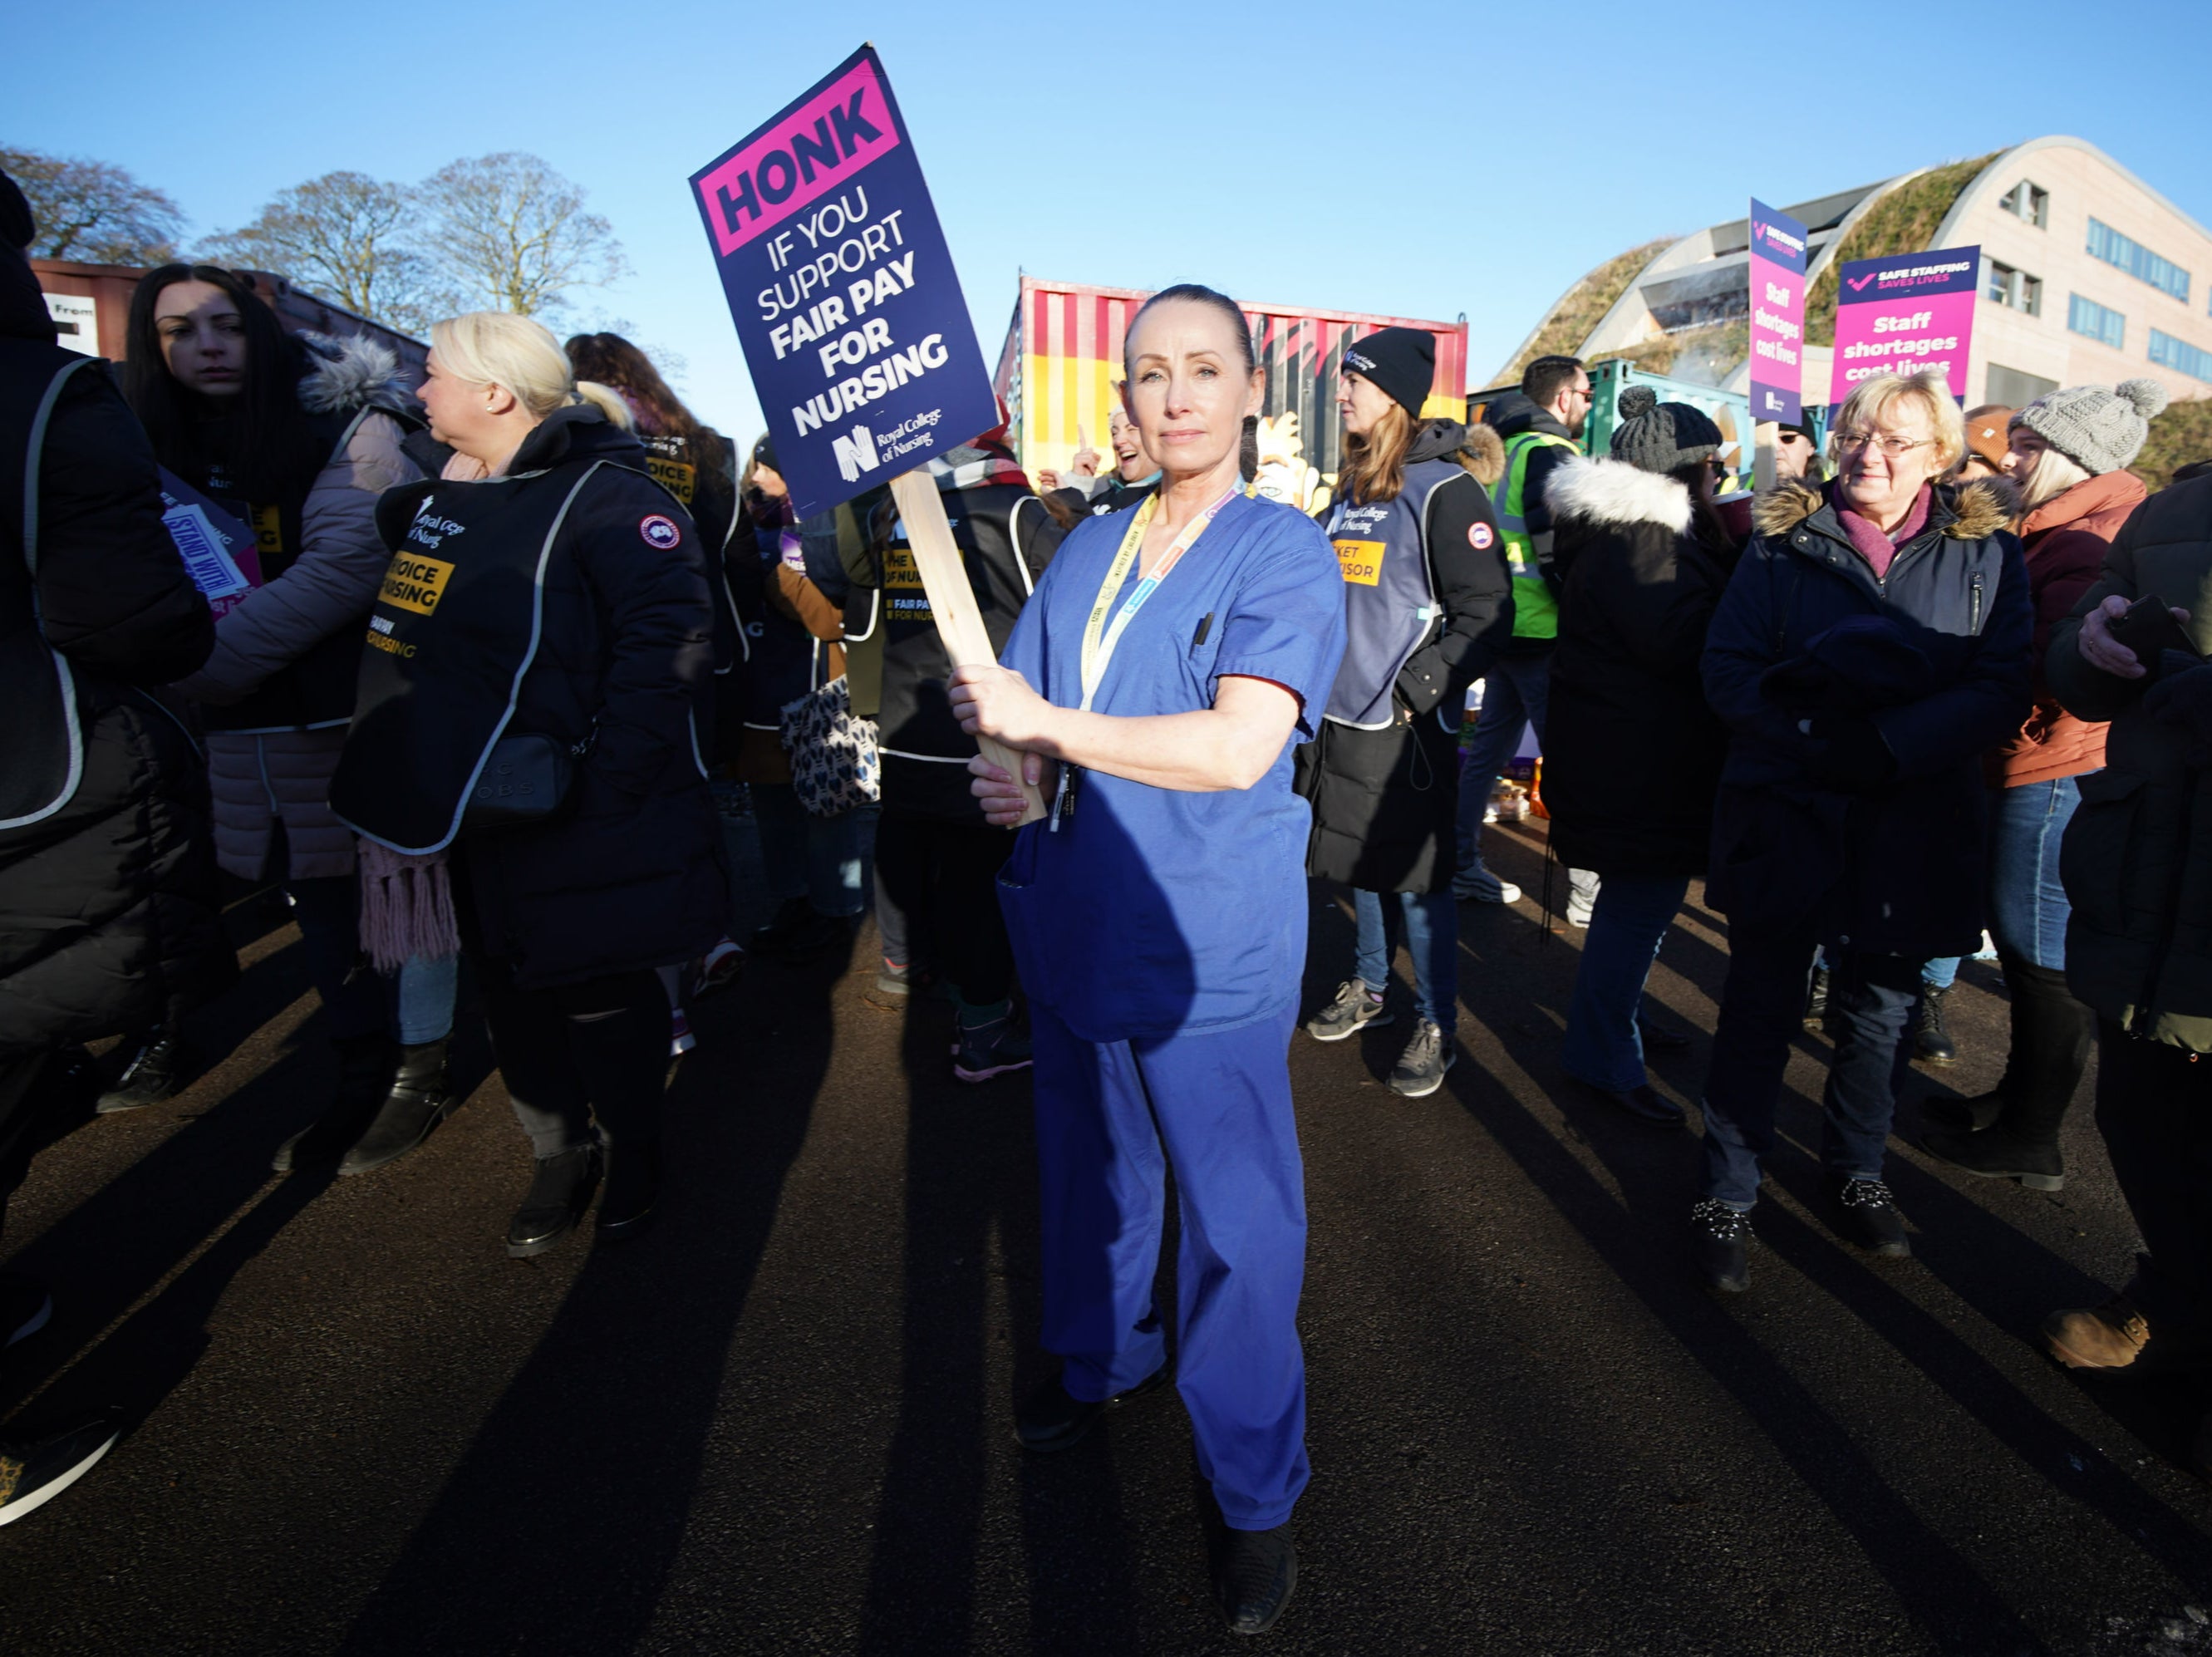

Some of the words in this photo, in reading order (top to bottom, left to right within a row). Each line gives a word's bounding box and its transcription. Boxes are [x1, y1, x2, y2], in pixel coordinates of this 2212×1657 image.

[716, 86, 884, 235] HONK
[766, 230, 794, 272] IF
[797, 185, 869, 249] YOU
[758, 209, 904, 322] SUPPORT
[1878, 268, 1910, 281] SAFE
[1910, 261, 1970, 277] STAFFING
[1877, 278, 1915, 289] SAVES
[1916, 273, 1950, 285] LIVES
[769, 296, 849, 361] FAIR
[848, 250, 915, 316] PAY
[1766, 282, 1790, 307] Staff
[55, 304, 93, 316] From
[1873, 311, 1933, 333] Staff
[1754, 307, 1800, 340] shortages
[818, 317, 894, 378] FOR
[1756, 339, 1776, 360] cost
[1776, 342, 1797, 366] lives
[1843, 337, 1959, 358] shortages
[792, 332, 949, 437] NURSING
[877, 423, 906, 447] Royal
[904, 409, 942, 432] College
[882, 447, 894, 462] of
[893, 431, 934, 457] Nursing
[648, 463, 687, 482] OICE
[1360, 506, 1389, 522] College
[168, 518, 210, 558] STAND
[193, 558, 232, 592] WITH
[1334, 546, 1359, 558] KET
[1339, 563, 1374, 578] ISOR
[894, 599, 915, 610] FAIR
[916, 599, 931, 610] PA
[477, 782, 534, 799] OBS
